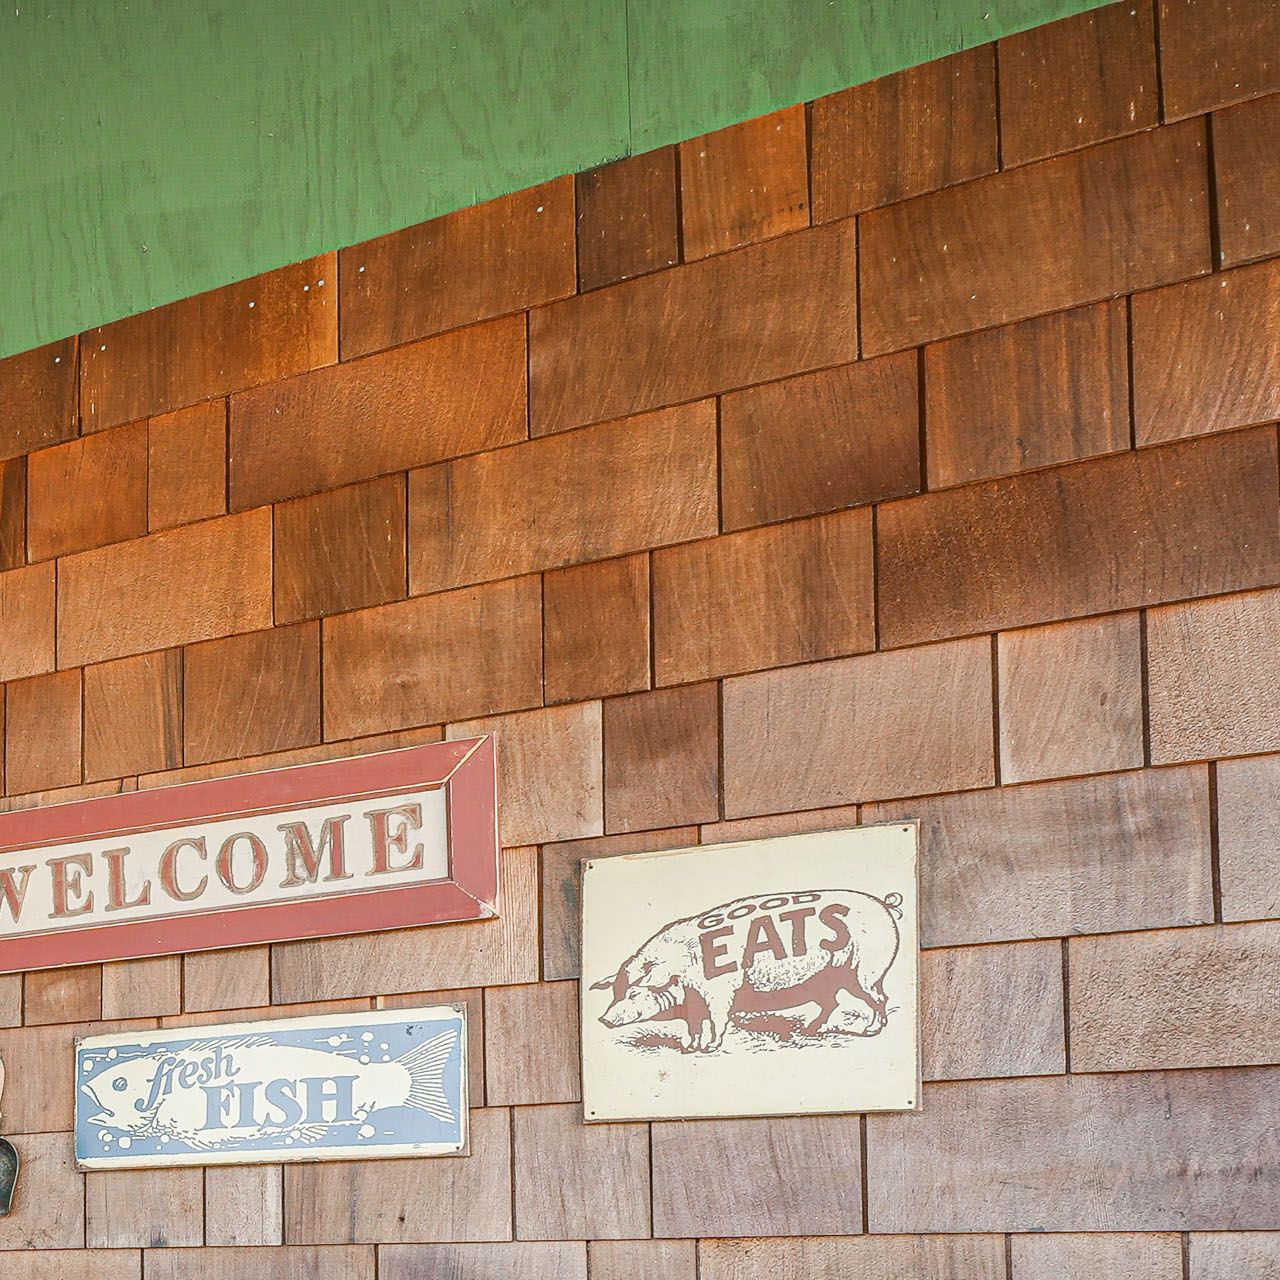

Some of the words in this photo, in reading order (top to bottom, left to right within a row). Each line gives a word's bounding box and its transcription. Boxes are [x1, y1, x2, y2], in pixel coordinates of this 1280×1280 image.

[697, 893, 822, 929] GOOD
[699, 903, 851, 981] EATS
[137, 1047, 240, 1112] fresh
[199, 1074, 360, 1130] FISH
